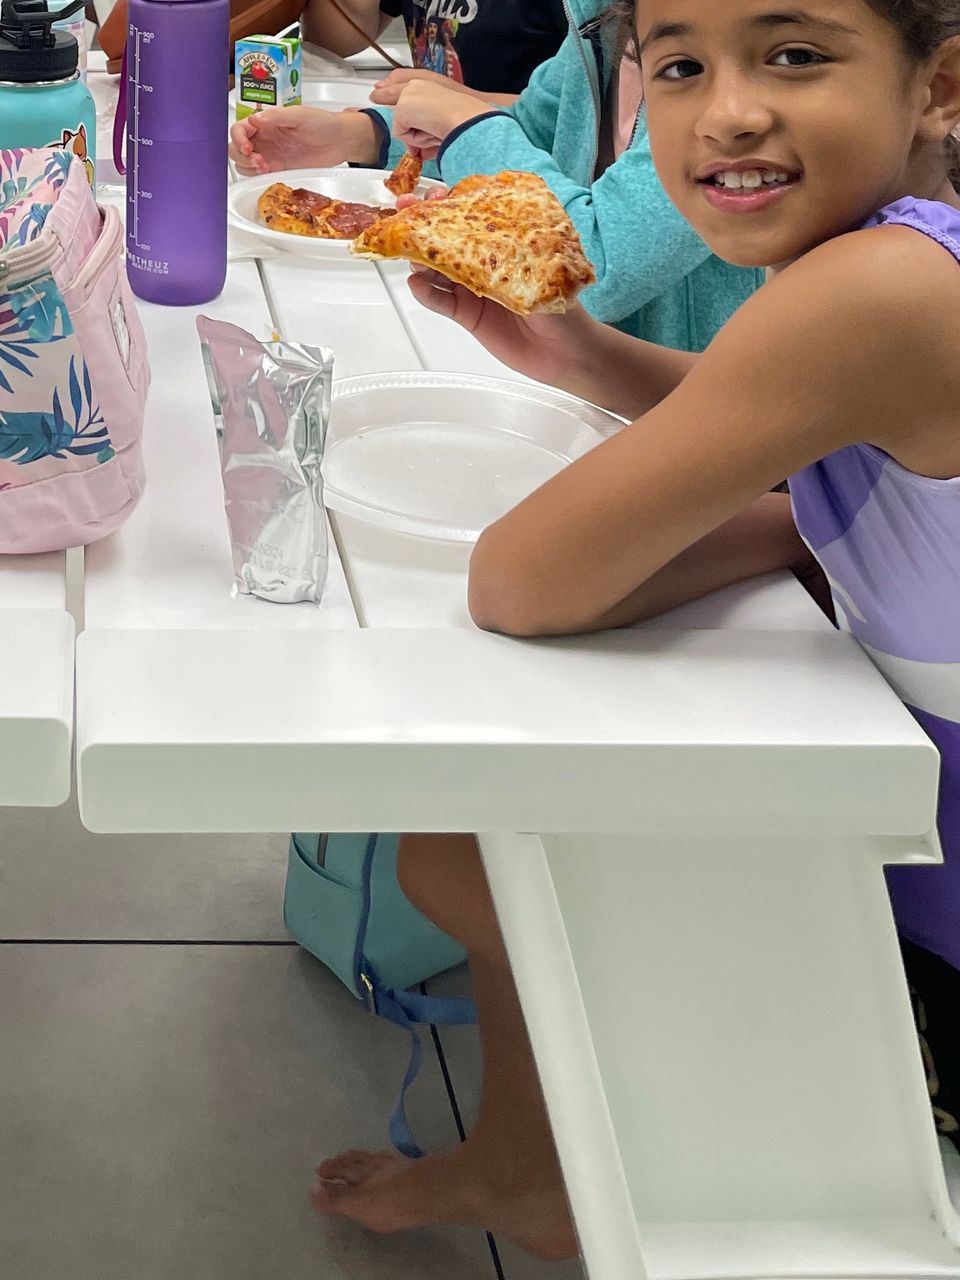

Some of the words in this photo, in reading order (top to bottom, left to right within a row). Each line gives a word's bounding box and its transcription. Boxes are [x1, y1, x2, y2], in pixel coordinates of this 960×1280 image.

[243, 52, 260, 64] APPLE
[142, 84, 153, 92] 700
[260, 82, 274, 90] JUICE
[141, 138, 153, 146] 500
